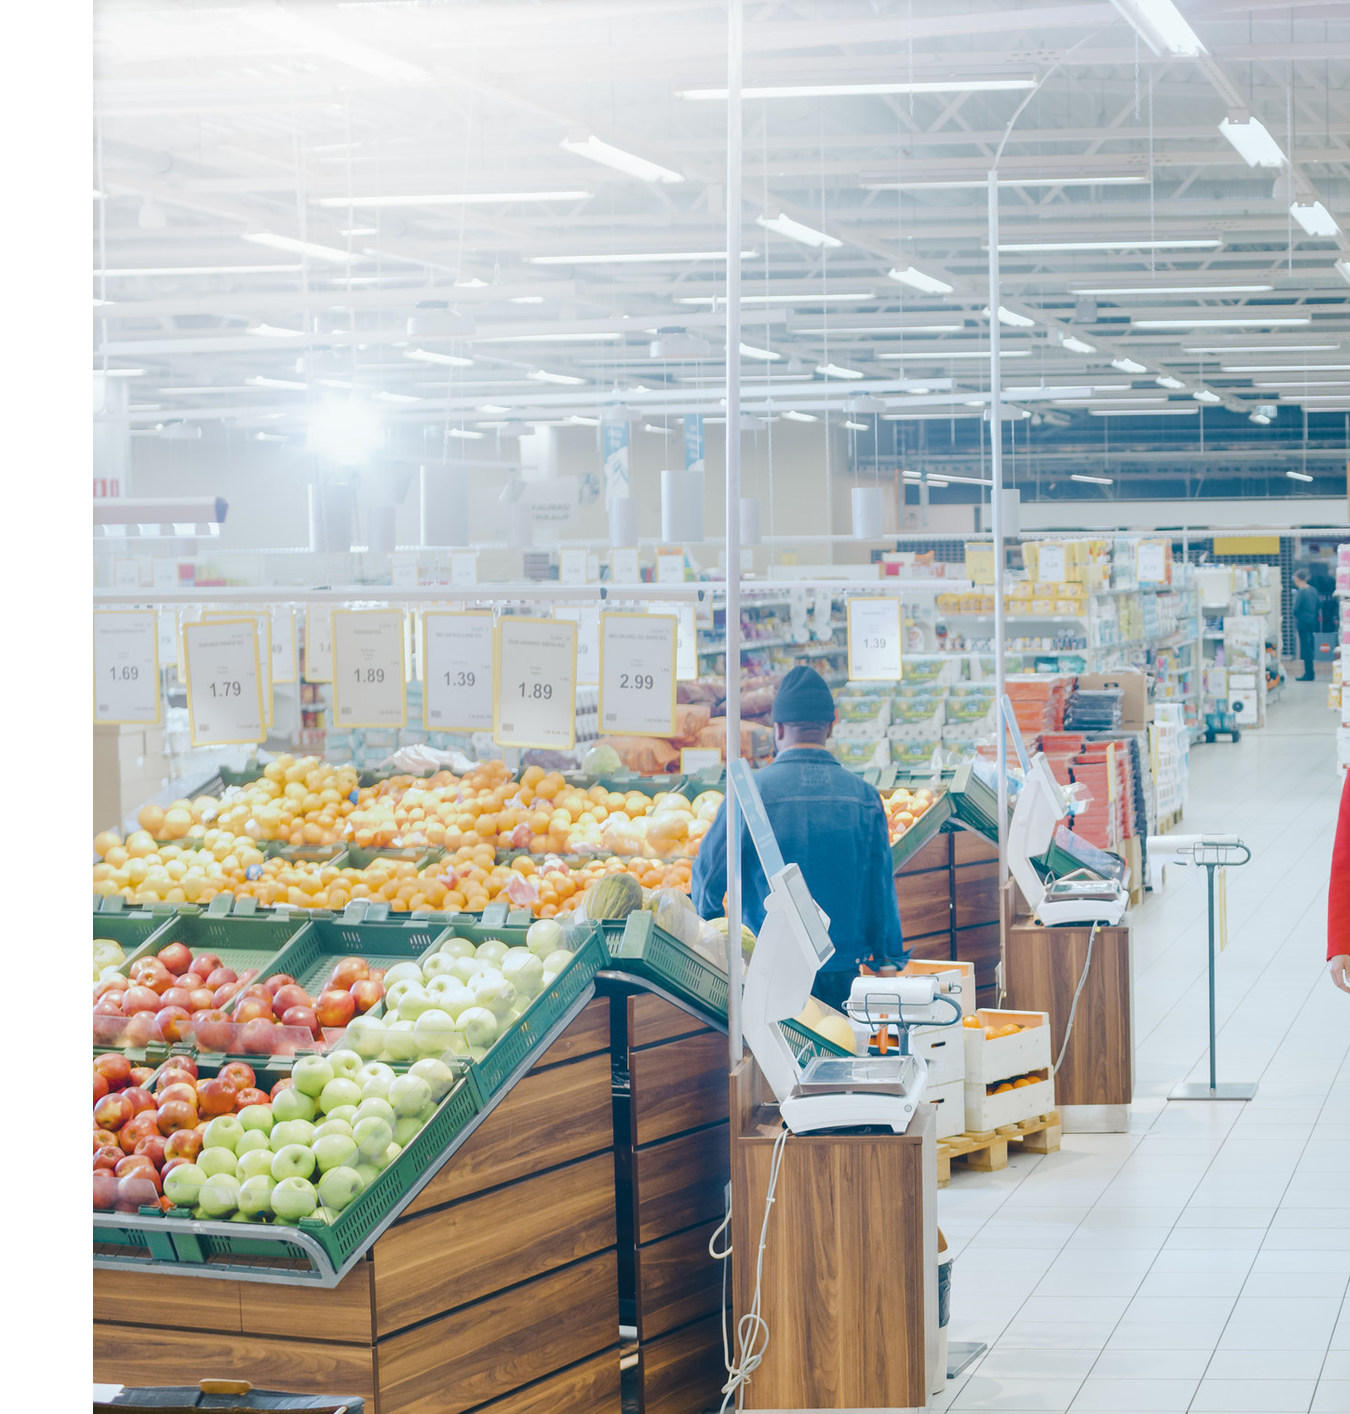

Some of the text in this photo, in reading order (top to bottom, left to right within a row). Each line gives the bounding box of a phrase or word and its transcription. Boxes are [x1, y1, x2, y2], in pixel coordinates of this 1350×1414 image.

[863, 638, 886, 649] 1.39
[109, 665, 139, 681] 1.69
[353, 667, 385, 683] 1.89
[443, 671, 476, 687] 1.39
[209, 680, 242, 698] 1.79
[619, 673, 654, 690] 2.99
[518, 681, 553, 700] 1.89
